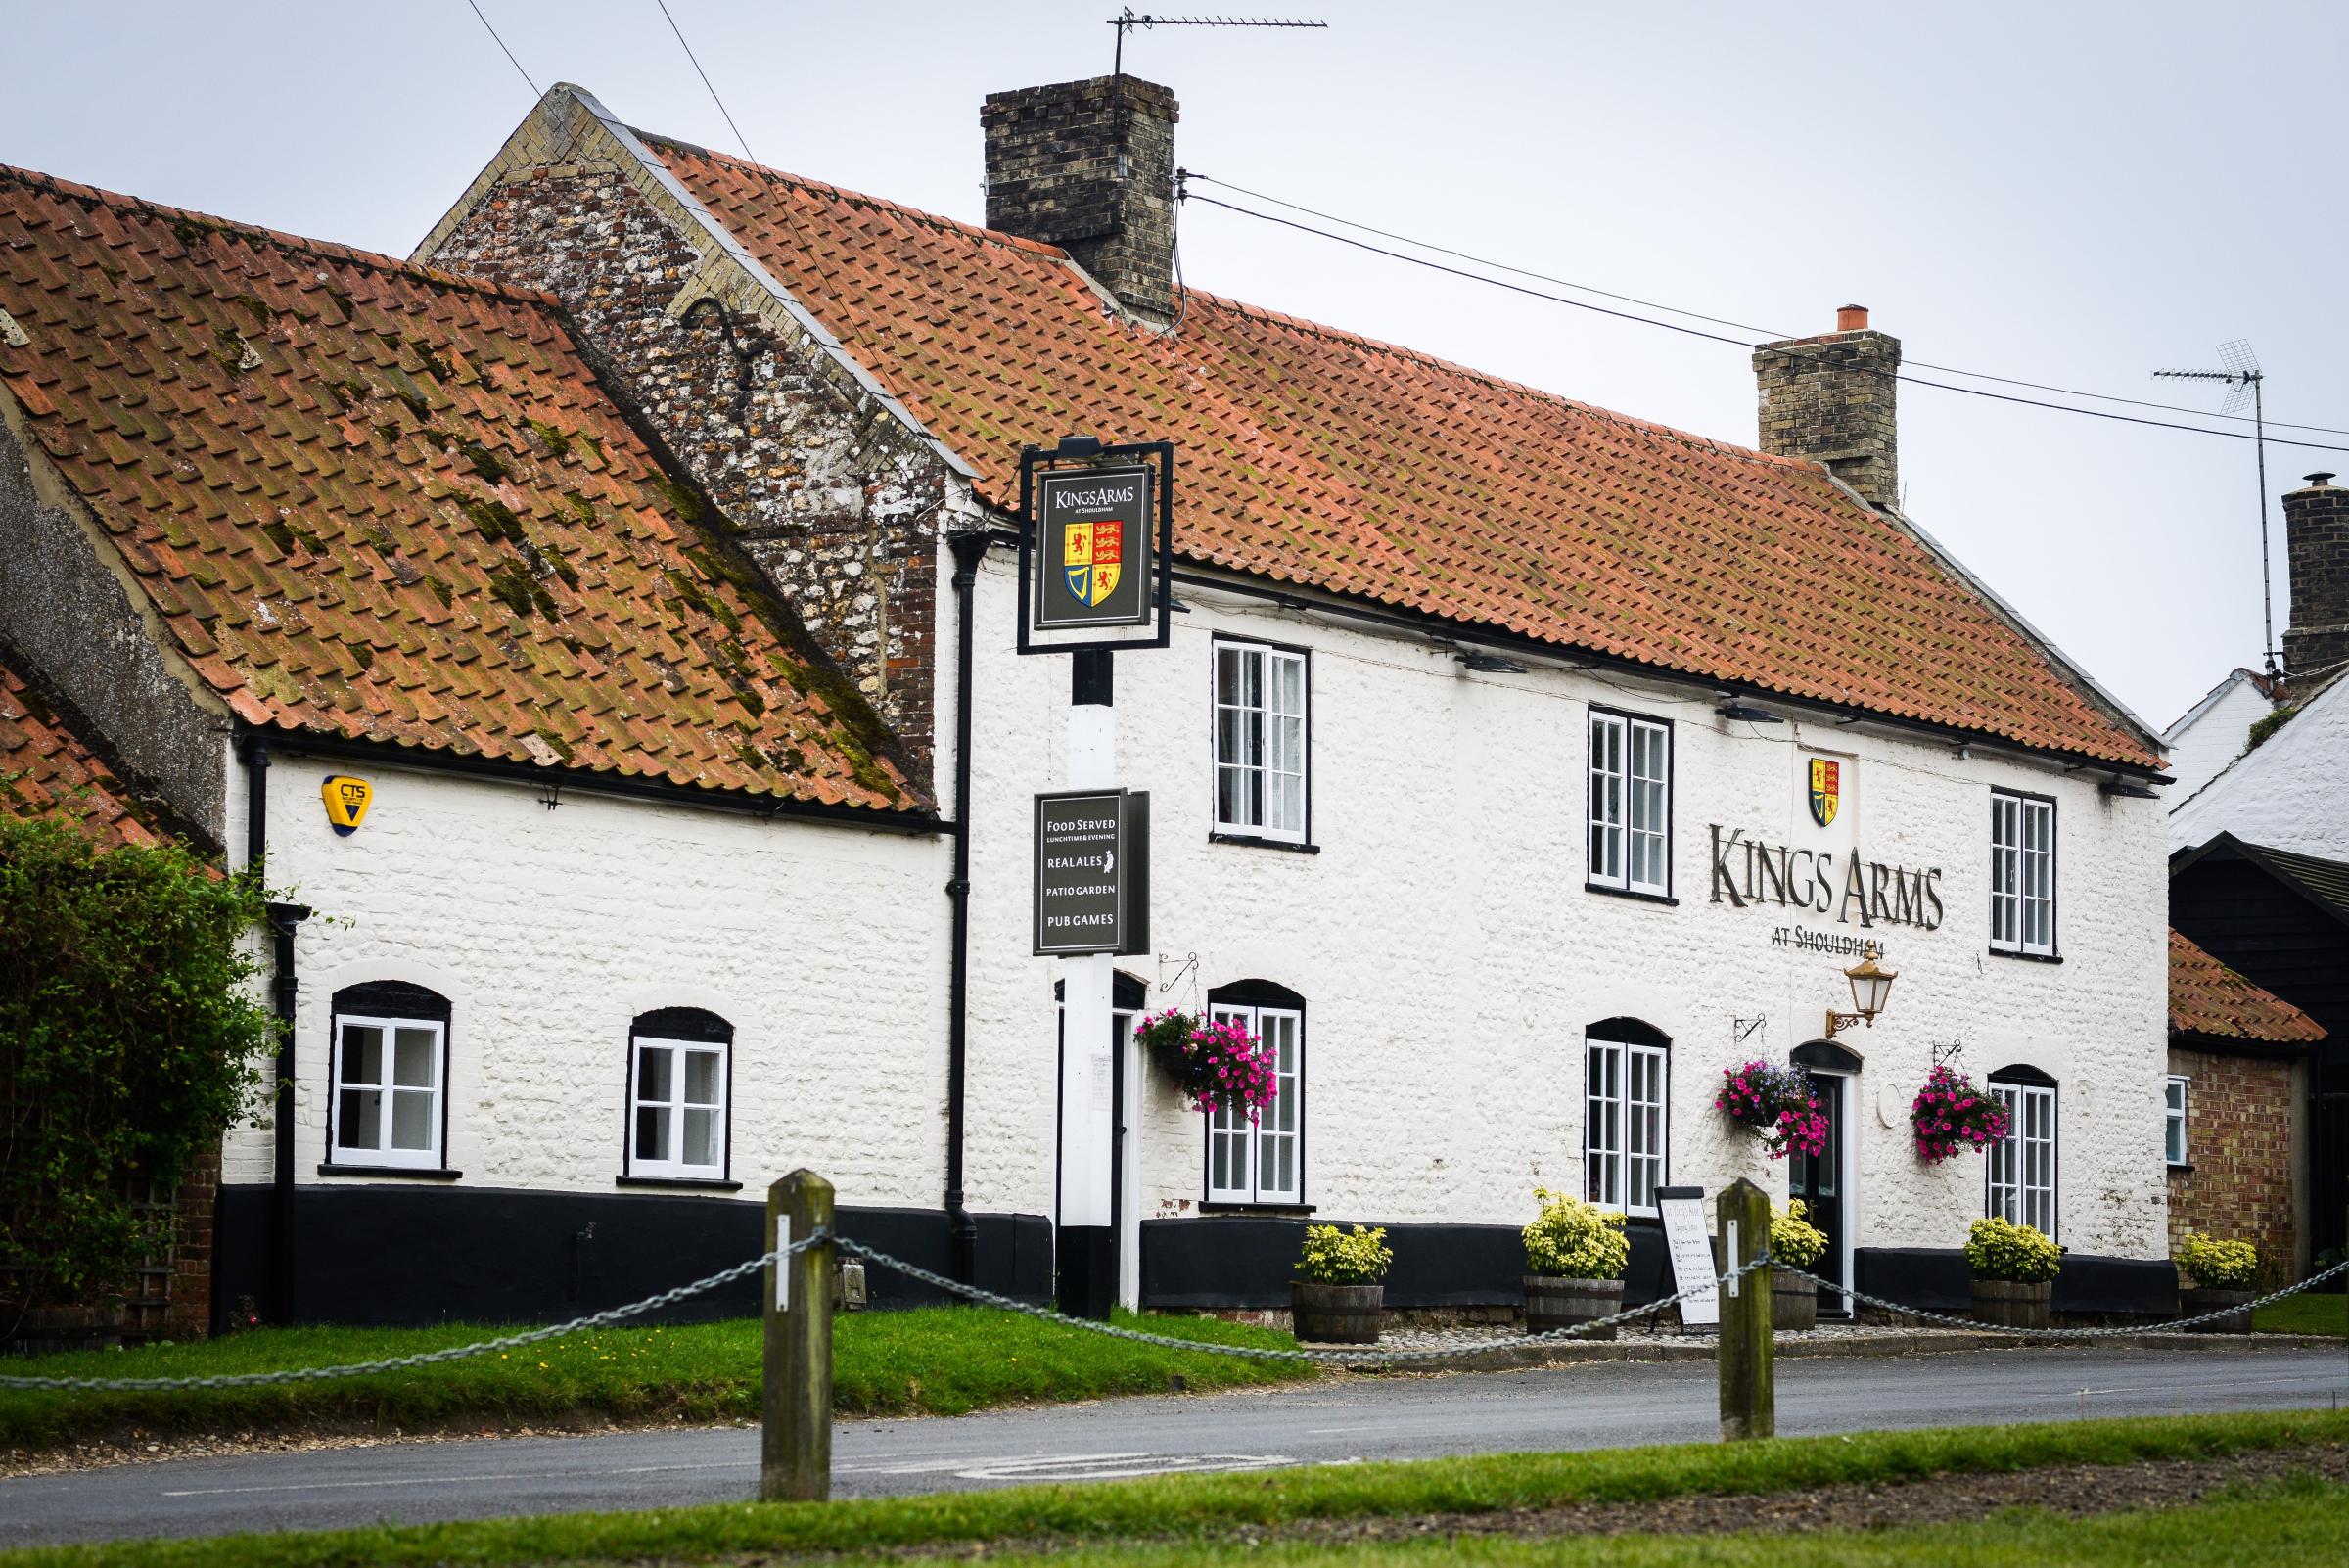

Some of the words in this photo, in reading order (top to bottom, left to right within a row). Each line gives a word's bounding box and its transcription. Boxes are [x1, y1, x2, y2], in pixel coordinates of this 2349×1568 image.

[1055, 490, 1096, 509] KINGS
[1095, 486, 1134, 506] ARMS
[340, 783, 366, 798] CTS
[1047, 821, 1075, 832] FOOD
[1077, 819, 1116, 831] SERVED
[1047, 856, 1076, 869] REAL
[1076, 855, 1102, 867] ALES
[1709, 823, 1833, 913] KINGS
[1836, 846, 1944, 931] ARMS
[1046, 886, 1075, 897] PATIO
[1076, 884, 1116, 896] GARDEN
[1047, 916, 1071, 927] PUB
[1073, 913, 1114, 926] GAMES
[1773, 926, 1790, 946] AT
[1795, 924, 1885, 960] SHOULDHM
